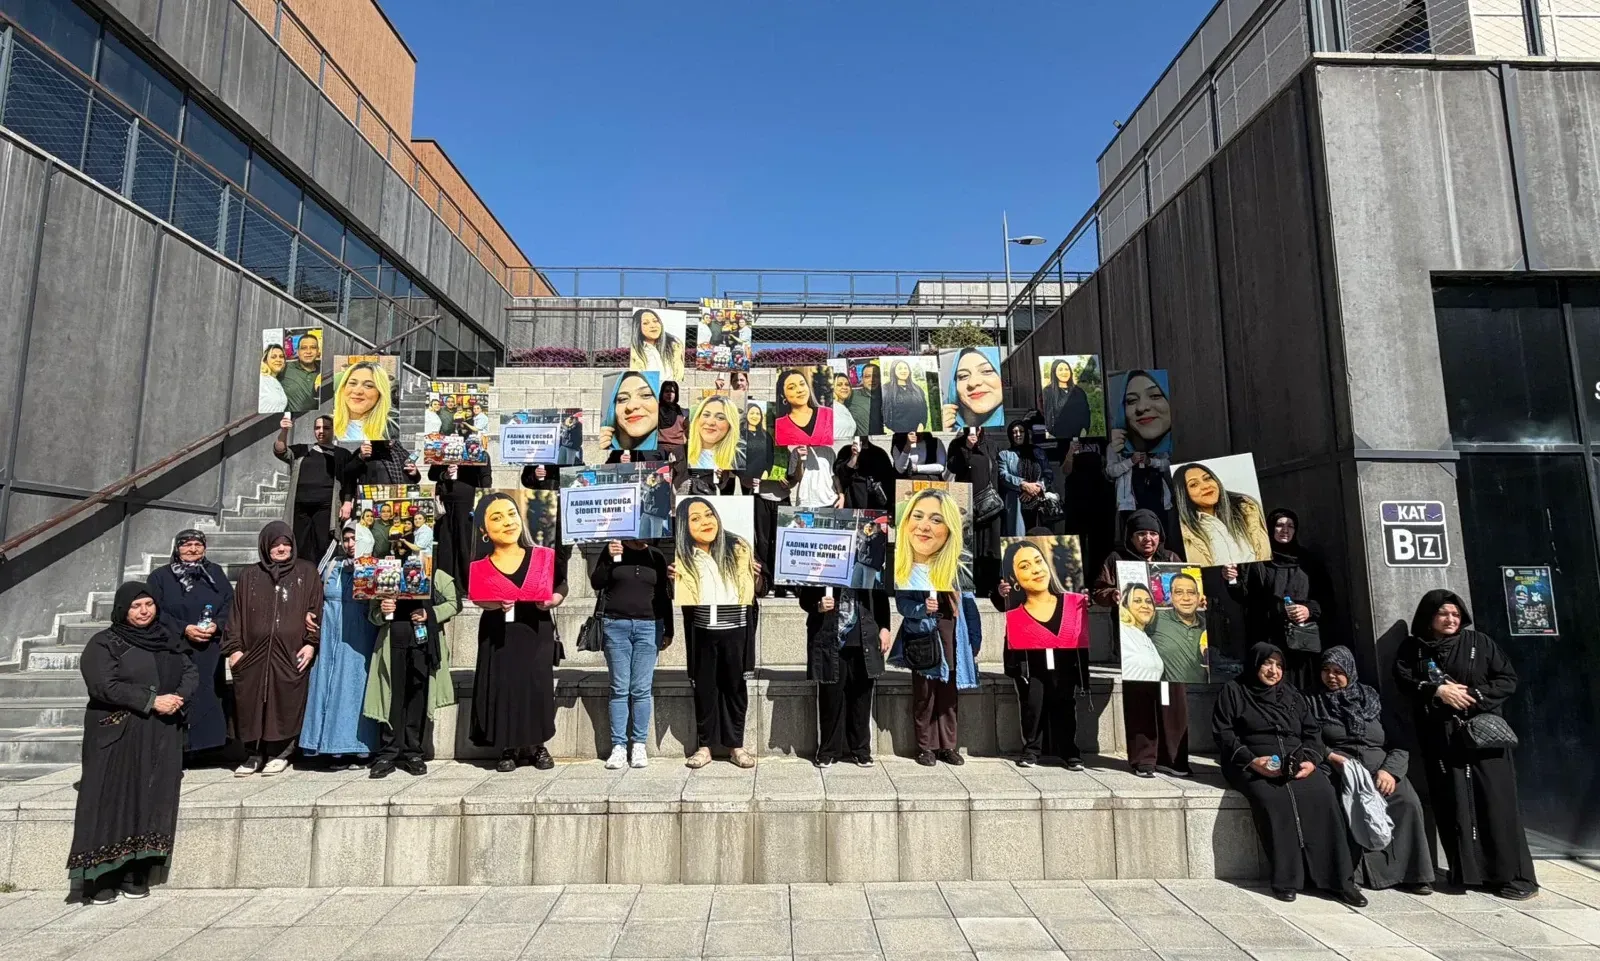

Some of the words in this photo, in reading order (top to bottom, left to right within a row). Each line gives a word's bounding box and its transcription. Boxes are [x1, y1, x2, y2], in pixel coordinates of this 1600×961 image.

[604, 498, 632, 506] ÇOCUĞA
[575, 507, 600, 515] ŞİDDETE
[1397, 505, 1426, 520] KAT
[818, 544, 846, 552] ÇOCUĞA
[790, 549, 815, 557] ŞİDDETE
